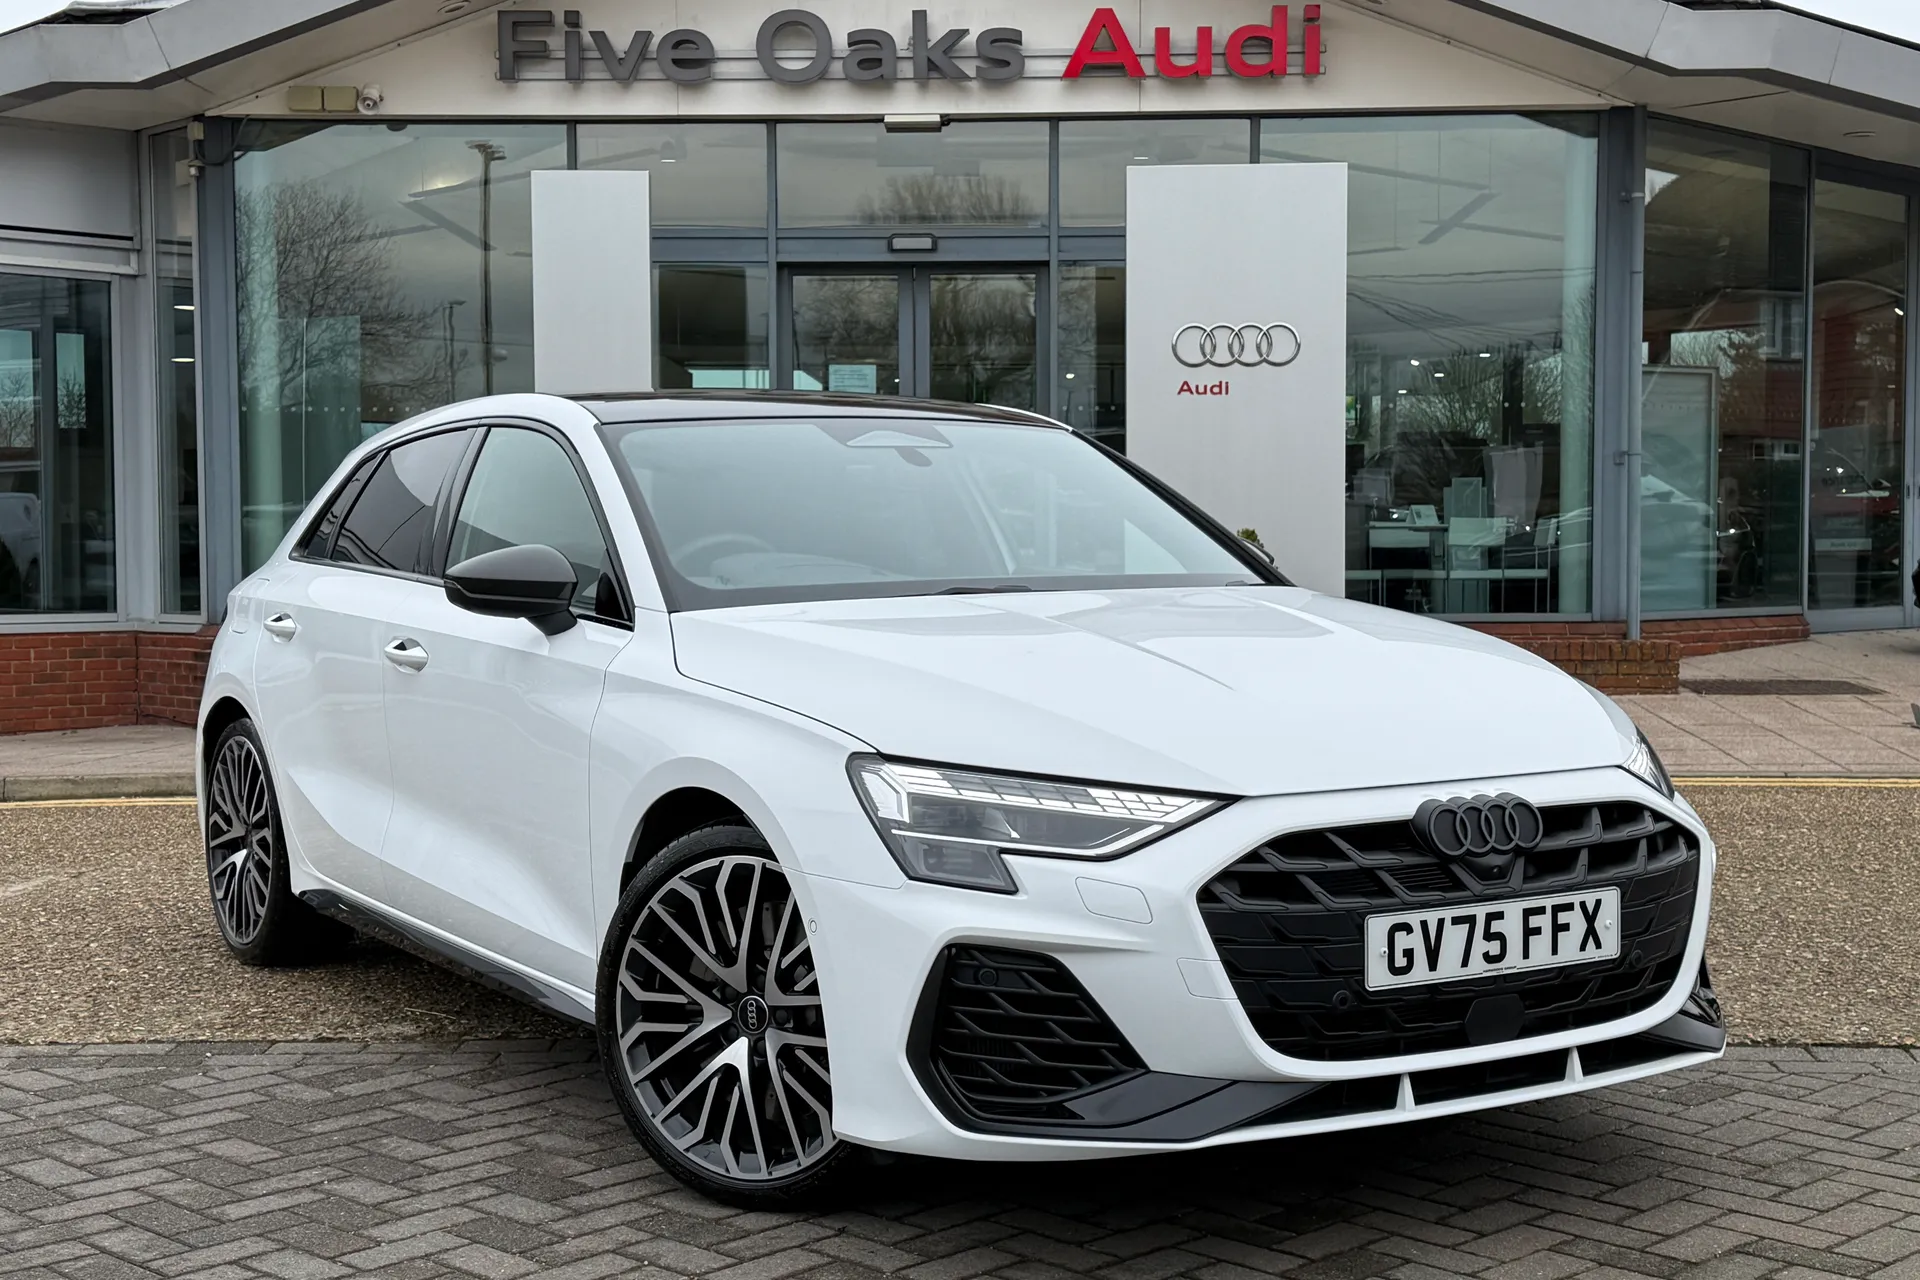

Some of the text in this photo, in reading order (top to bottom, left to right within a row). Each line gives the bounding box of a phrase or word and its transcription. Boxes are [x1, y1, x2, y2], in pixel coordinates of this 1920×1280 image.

[497, 5, 1321, 83] Five Oaks Audi
[1177, 380, 1230, 395] Audi
[1387, 898, 1603, 977] GV75 FFX
